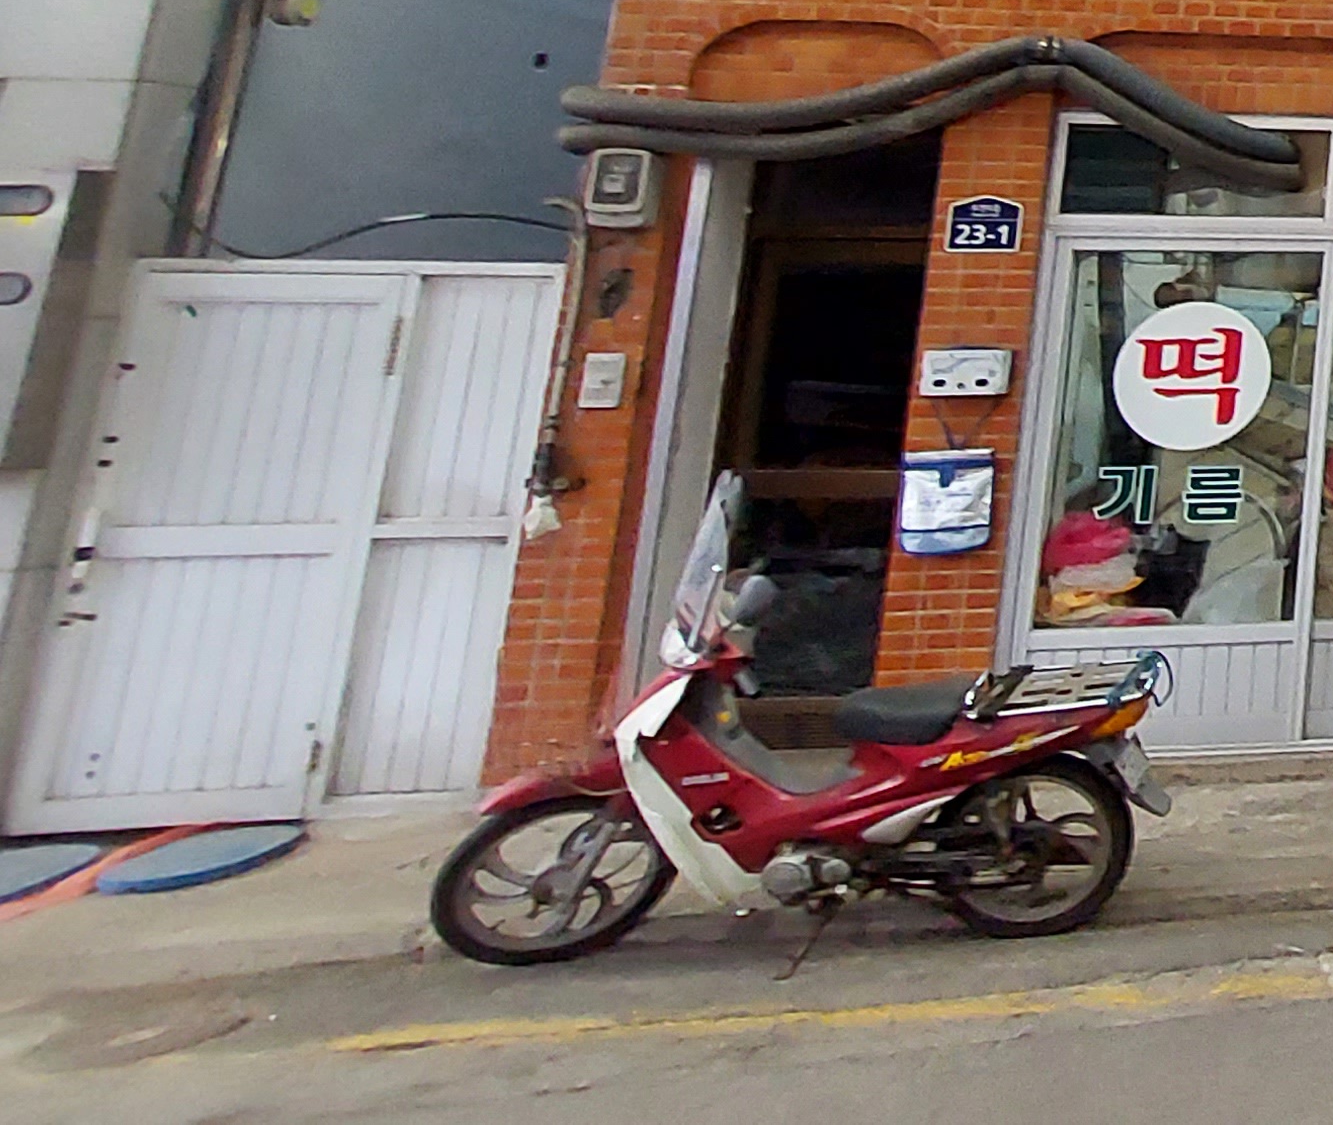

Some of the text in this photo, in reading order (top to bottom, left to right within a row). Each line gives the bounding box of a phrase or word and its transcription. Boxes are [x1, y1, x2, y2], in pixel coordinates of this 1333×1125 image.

[954, 224, 1010, 245] 23-1
[1136, 327, 1243, 425] 떡
[1093, 466, 1244, 525] 기름
